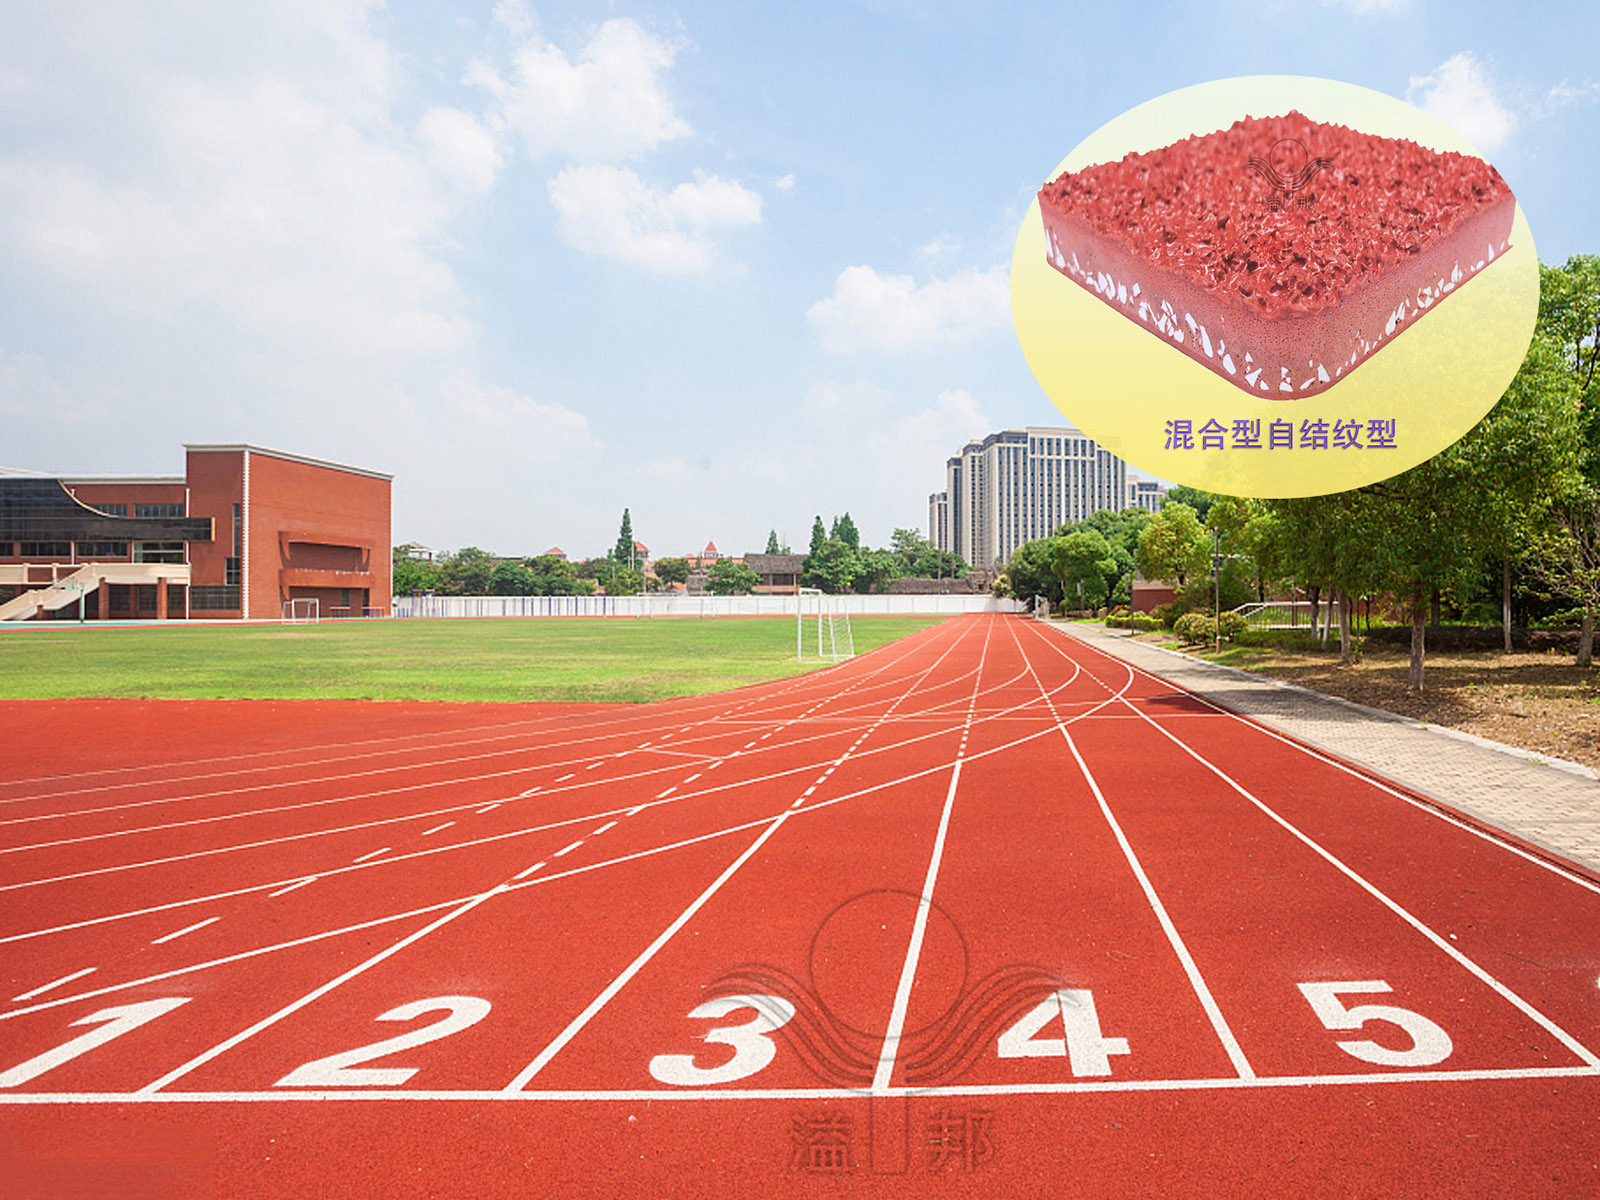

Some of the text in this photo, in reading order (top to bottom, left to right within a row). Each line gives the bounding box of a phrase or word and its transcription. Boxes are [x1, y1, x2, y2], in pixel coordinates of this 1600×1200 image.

[0, 997, 193, 1088] 1
[273, 995, 491, 1087] 2
[649, 995, 796, 1086] 3
[997, 989, 1131, 1077] 4
[1297, 980, 1454, 1068] 5
